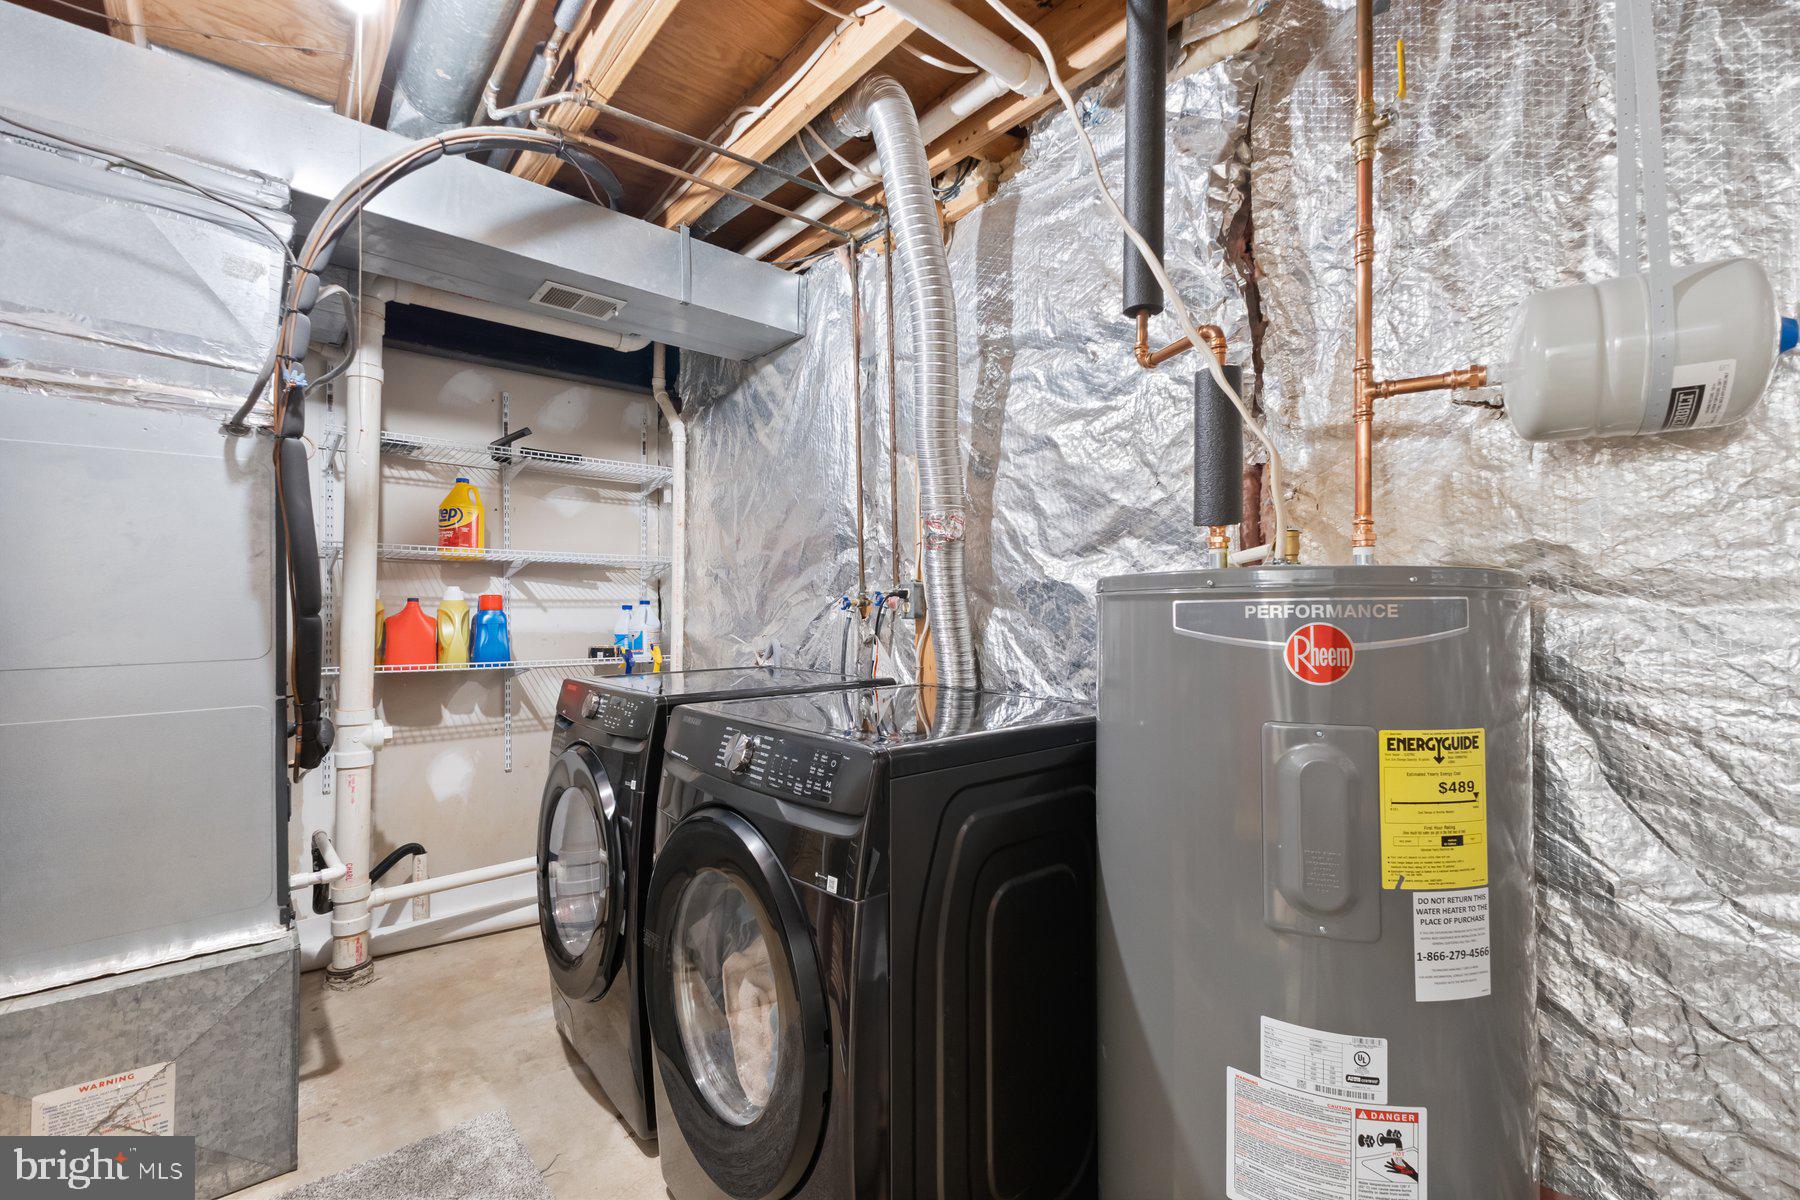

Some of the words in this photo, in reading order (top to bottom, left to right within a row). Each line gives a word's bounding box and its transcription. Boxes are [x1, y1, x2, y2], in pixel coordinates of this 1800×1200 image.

[1245, 604, 1399, 618] PERFORMANCE
[1293, 625, 1350, 674] Rheem
[1386, 736, 1479, 752] ENERGYGUIDE
[1438, 780, 1475, 794] $489
[1447, 895, 1473, 903] RETURN
[1442, 906, 1467, 914] HEATER
[1420, 918, 1442, 926] PLACE
[1443, 917, 1453, 925] OF
[1454, 914, 1485, 924] PURCHASE
[1416, 946, 1490, 961] 1-866-279-4566
[79, 1073, 135, 1093] WARNING
[1371, 1112, 1415, 1122] DANGER
